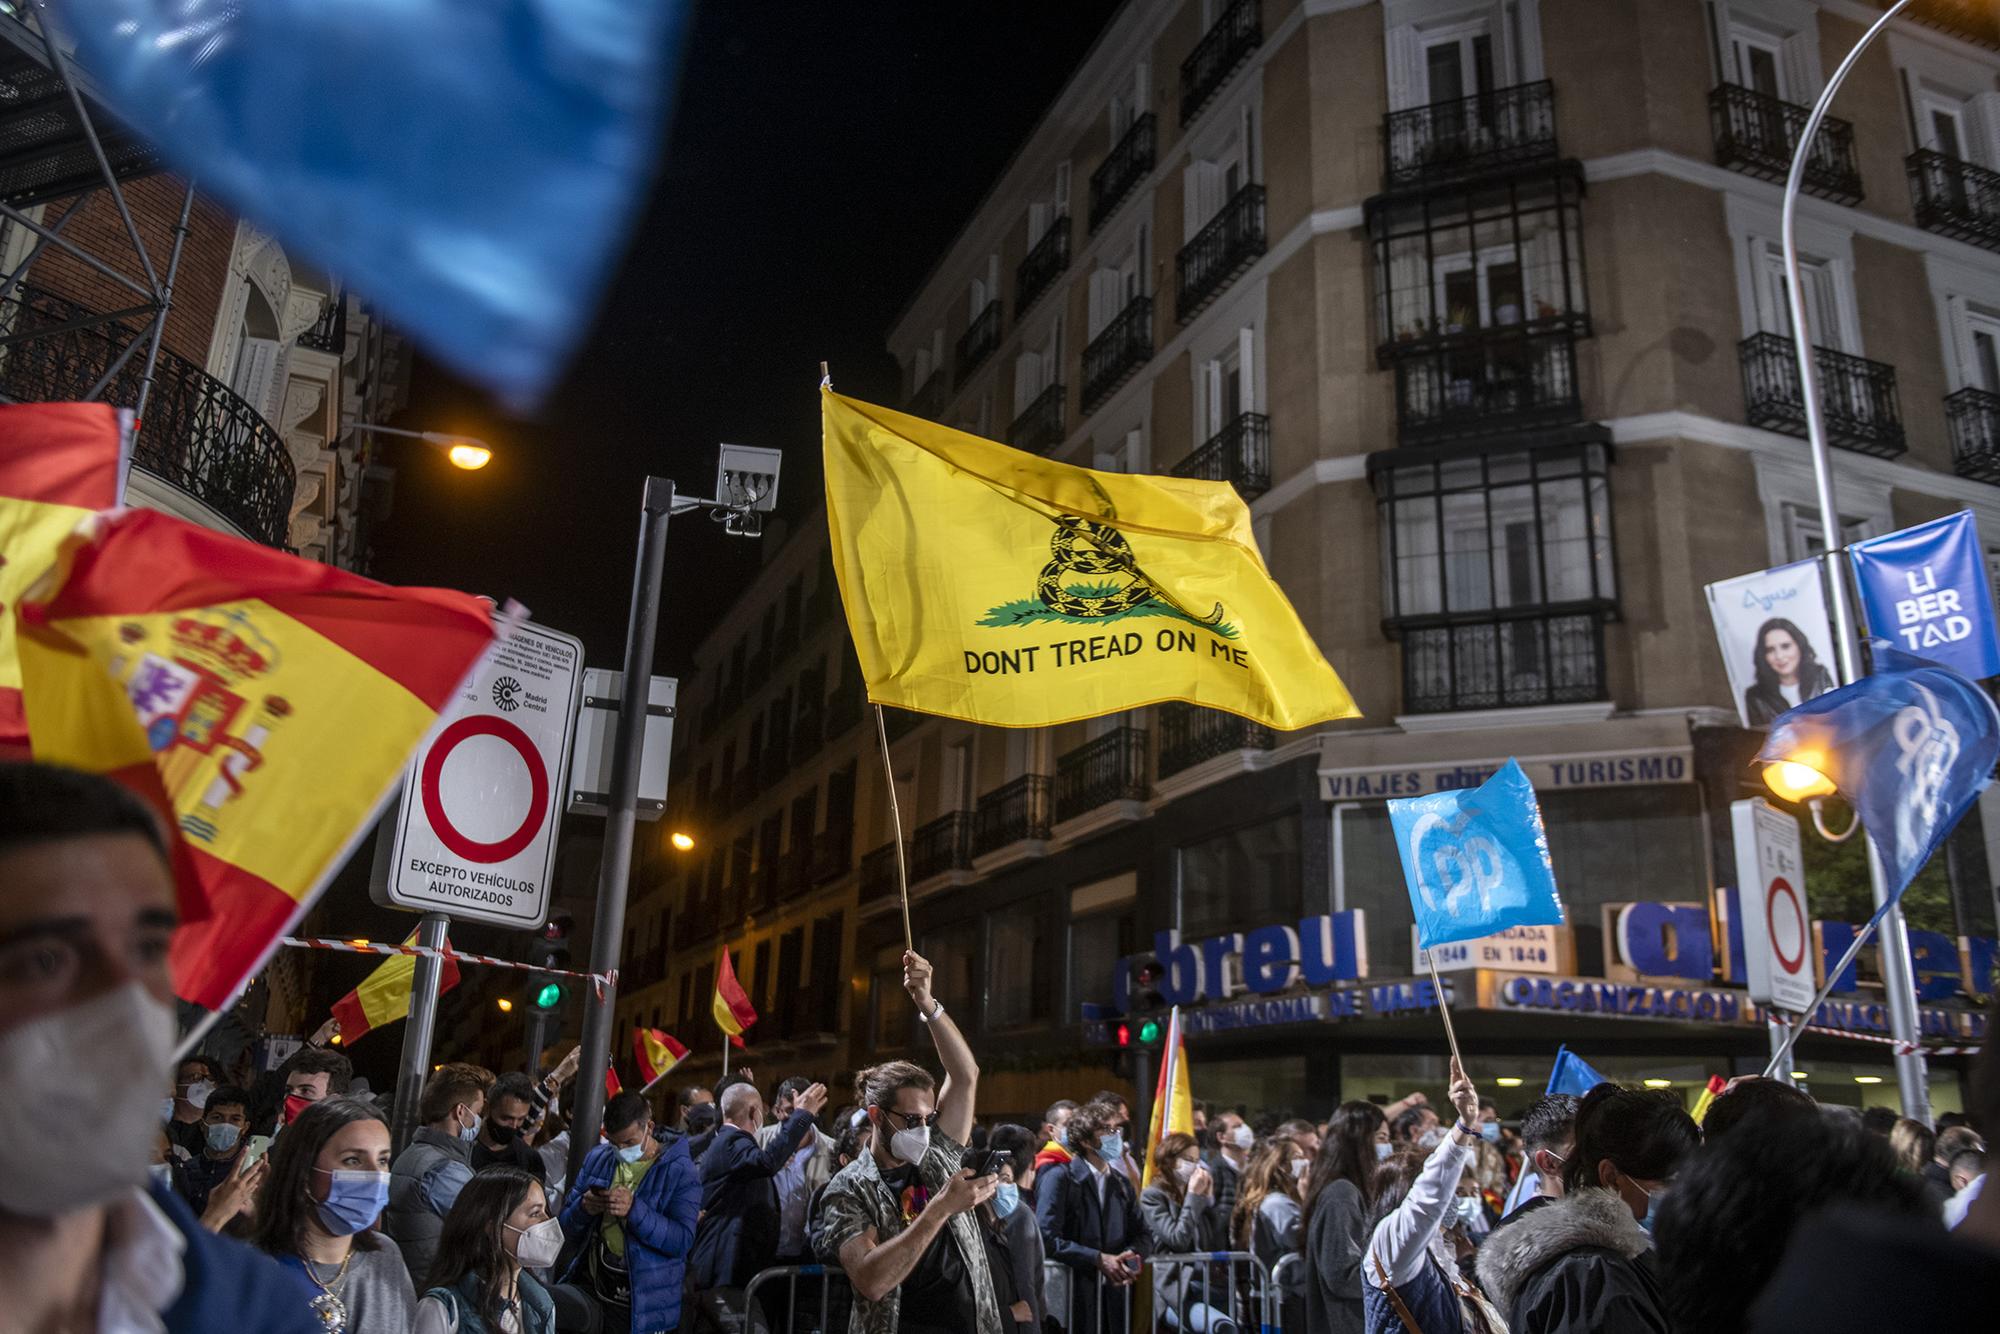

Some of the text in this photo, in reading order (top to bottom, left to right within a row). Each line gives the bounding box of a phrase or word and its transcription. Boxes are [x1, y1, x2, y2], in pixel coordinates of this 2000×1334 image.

[1906, 565, 1936, 594] LI
[1895, 588, 1963, 625] BER
[1899, 615, 1972, 651] TAD
[964, 629, 1249, 675] DONT TREAD ON ME
[523, 700, 547, 713] Central
[525, 692, 548, 705] Madrid
[1328, 771, 1420, 797] VIAJES
[1551, 755, 1684, 787] TURISMO
[410, 858, 535, 894] EXCEPTO VEHÍCULOS
[429, 880, 513, 907] AUTORIZADOS
[1482, 946, 1548, 963] EN 1840
